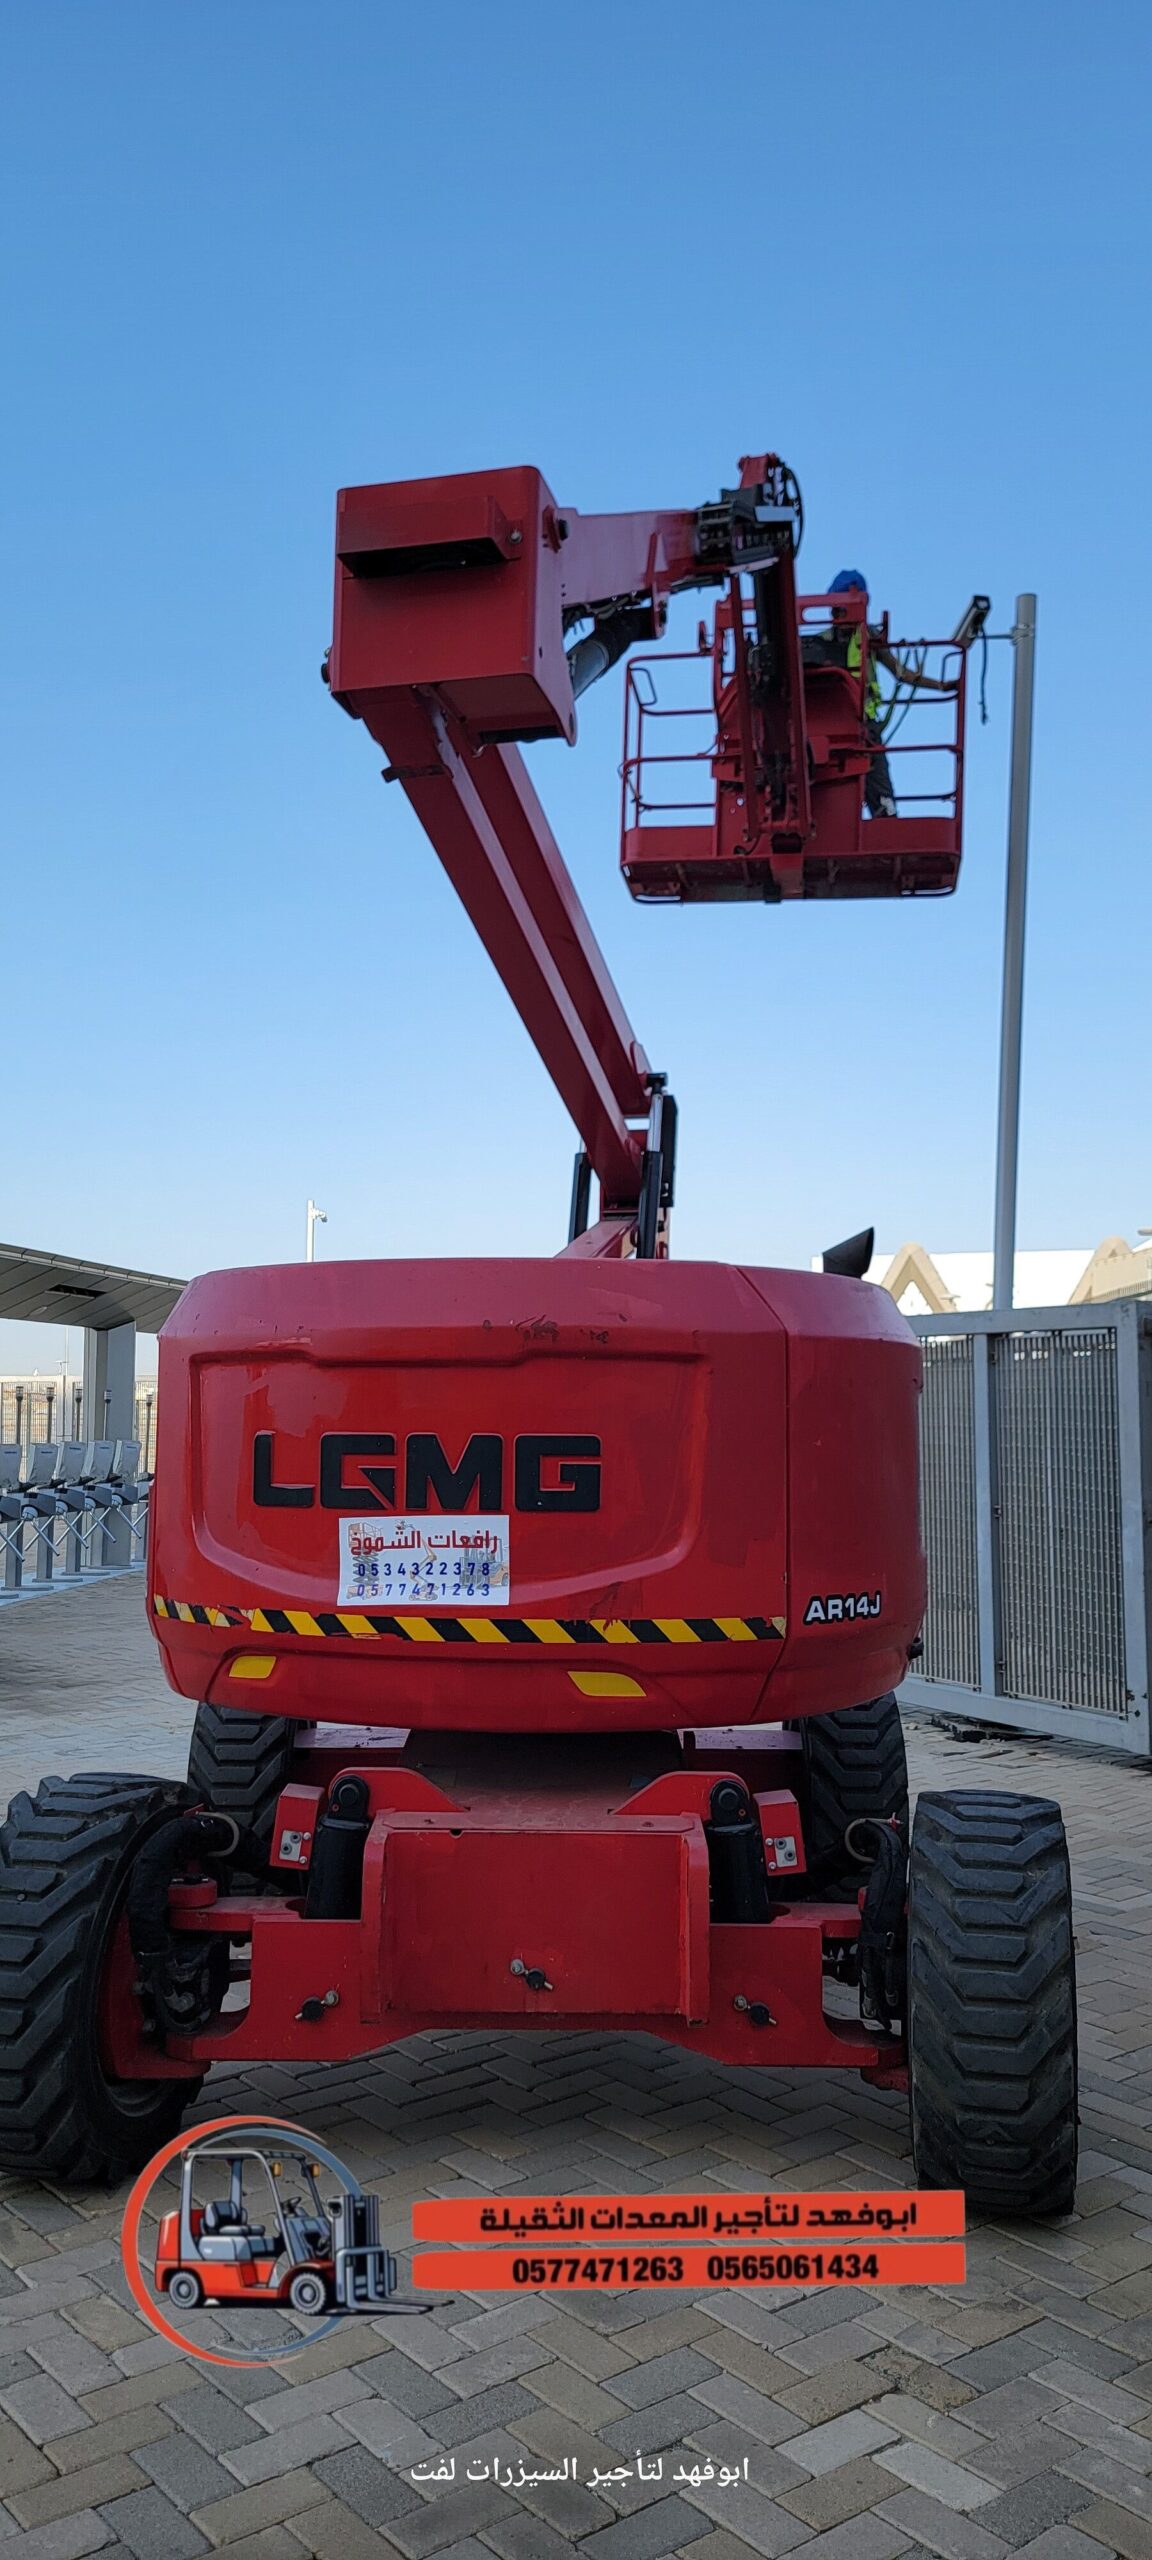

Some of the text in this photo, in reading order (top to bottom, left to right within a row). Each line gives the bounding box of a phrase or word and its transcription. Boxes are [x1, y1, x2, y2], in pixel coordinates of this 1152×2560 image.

[253, 1431, 602, 1512] LGMG
[350, 1526, 498, 1556] رافعات الشموخ
[357, 1562, 491, 1577] 0534322378
[356, 1583, 491, 1597] 0577471263
[804, 1592, 881, 1623] AR14J
